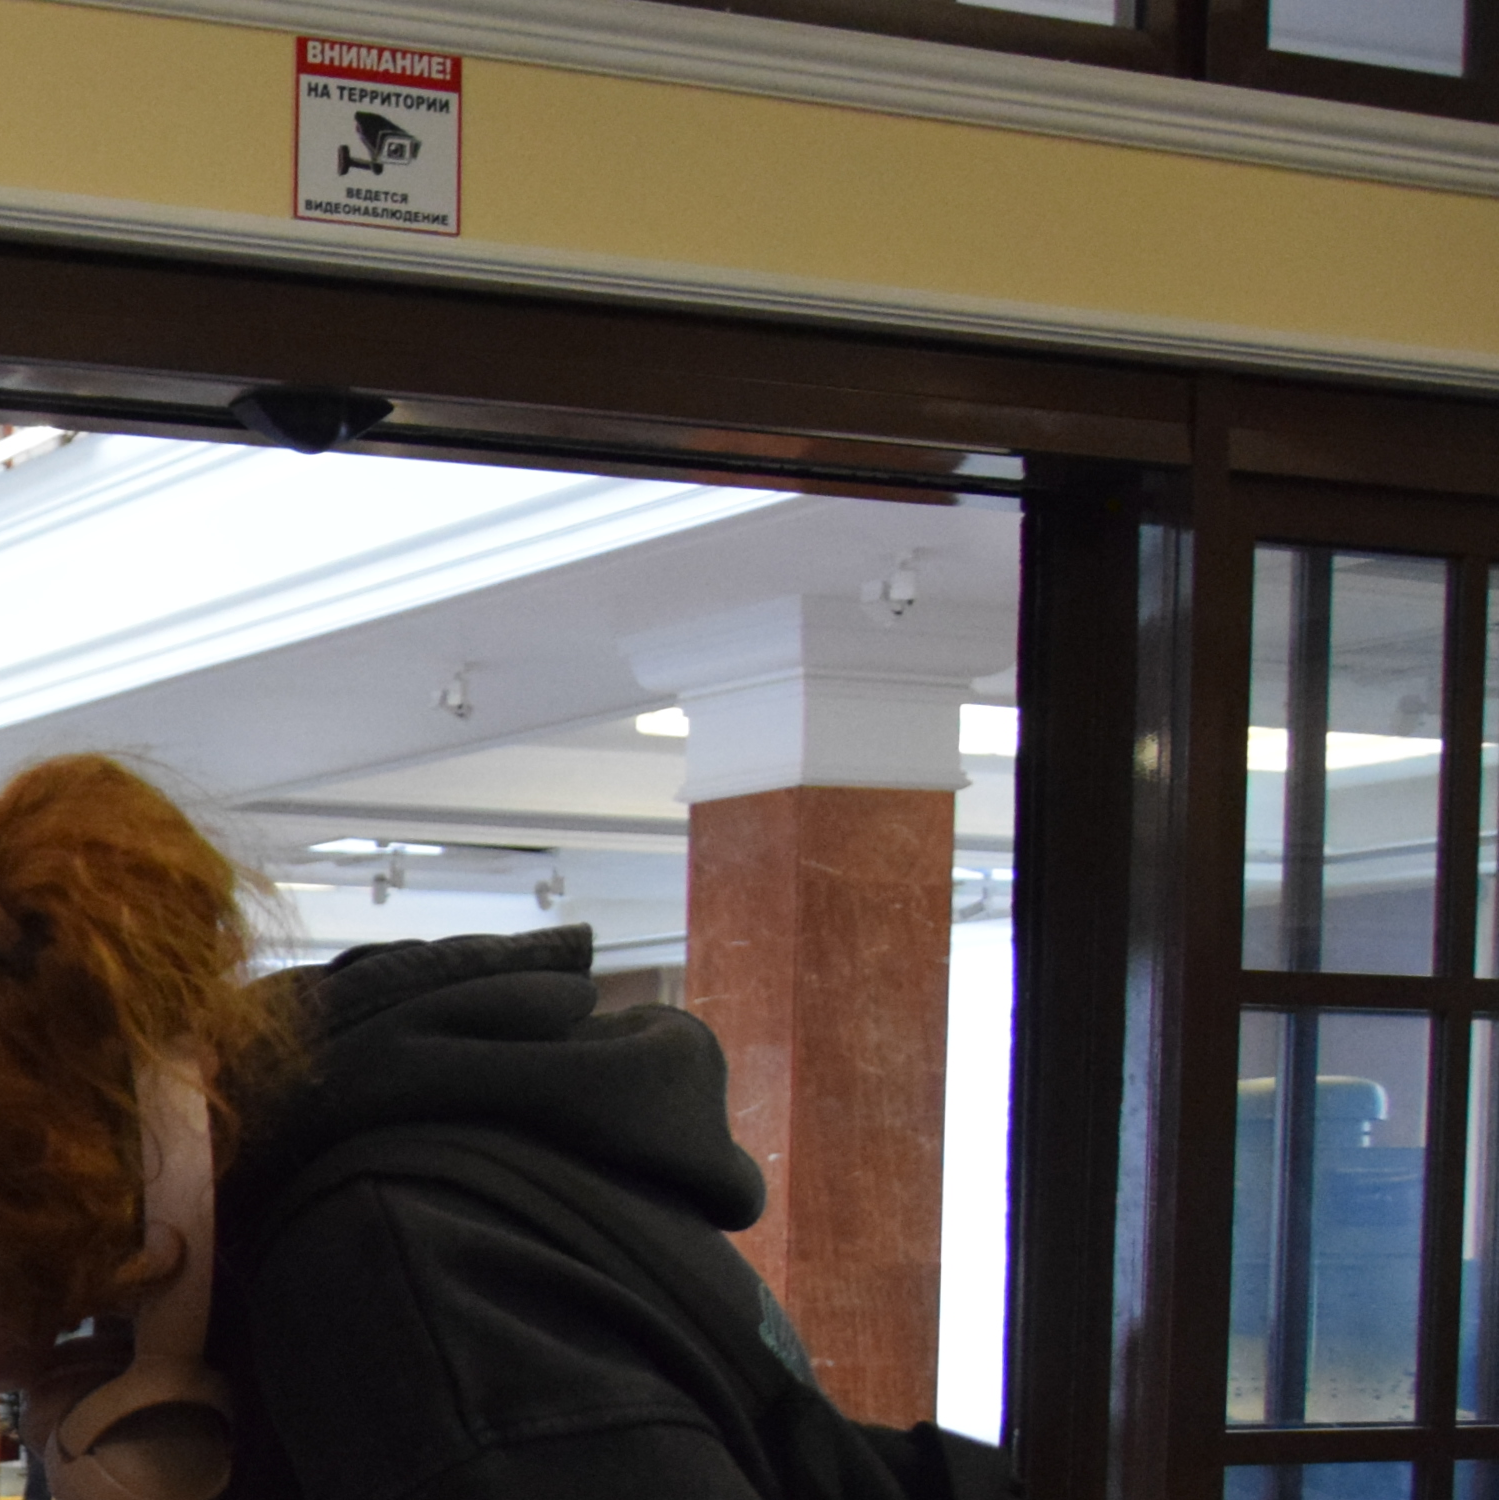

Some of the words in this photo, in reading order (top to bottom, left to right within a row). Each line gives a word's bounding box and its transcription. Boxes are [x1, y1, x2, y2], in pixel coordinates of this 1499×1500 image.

[306, 40, 452, 81] ВНИМАНИЕ!
[307, 82, 331, 99] НА
[336, 85, 451, 113] ТЕРРИТОРИИ
[345, 187, 409, 204] ВЕДЕТСЯ
[304, 199, 450, 226] ВИДЕОНАБЛЮДЕНИЕ
